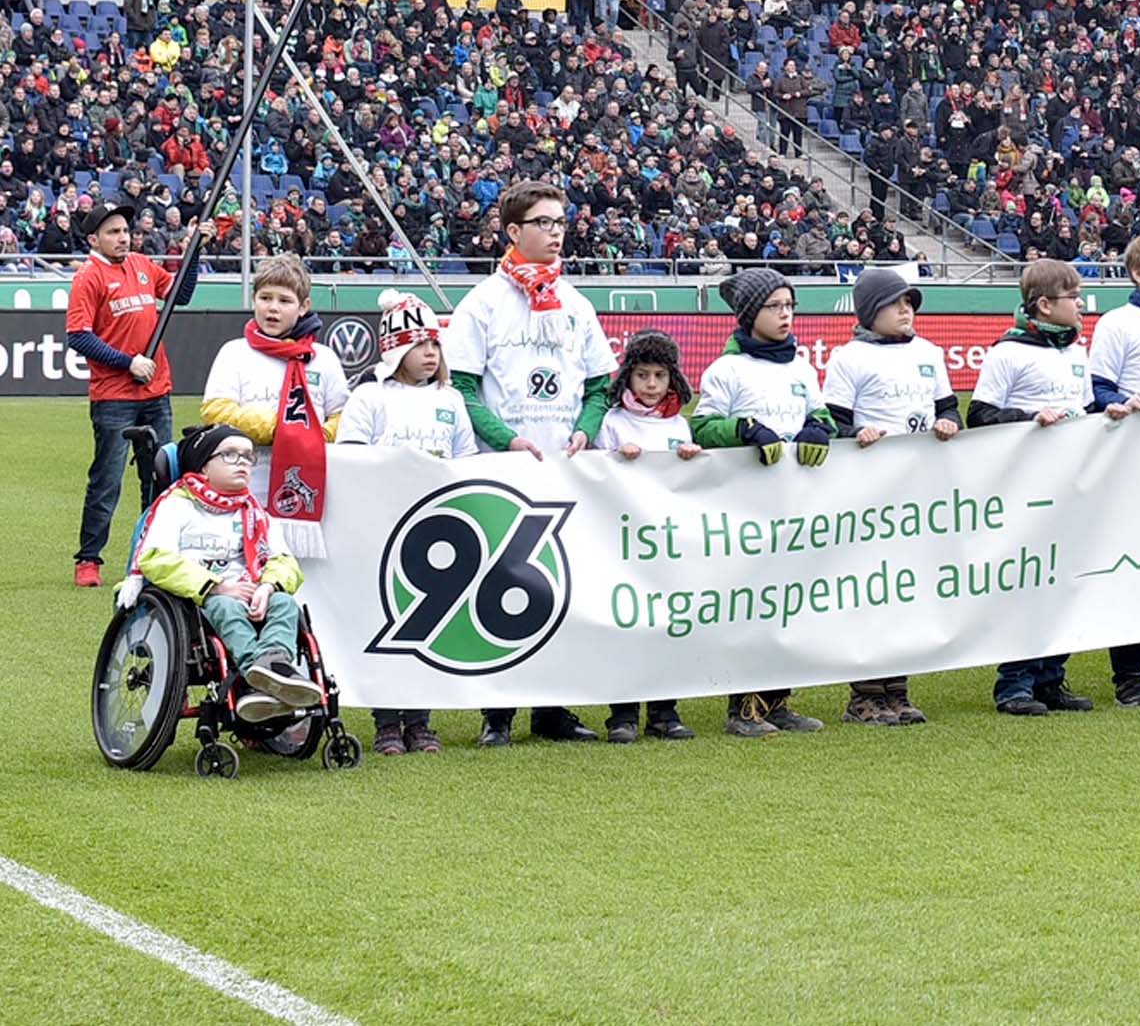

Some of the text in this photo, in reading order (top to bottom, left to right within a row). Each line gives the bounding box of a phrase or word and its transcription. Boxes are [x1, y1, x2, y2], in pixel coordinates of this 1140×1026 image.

[530, 372, 558, 396] 96
[908, 416, 928, 434] 96
[620, 514, 682, 561] ist
[702, 488, 1004, 557] Herzenssache
[388, 508, 560, 650] 96
[611, 544, 1058, 638] Organspende auch!
